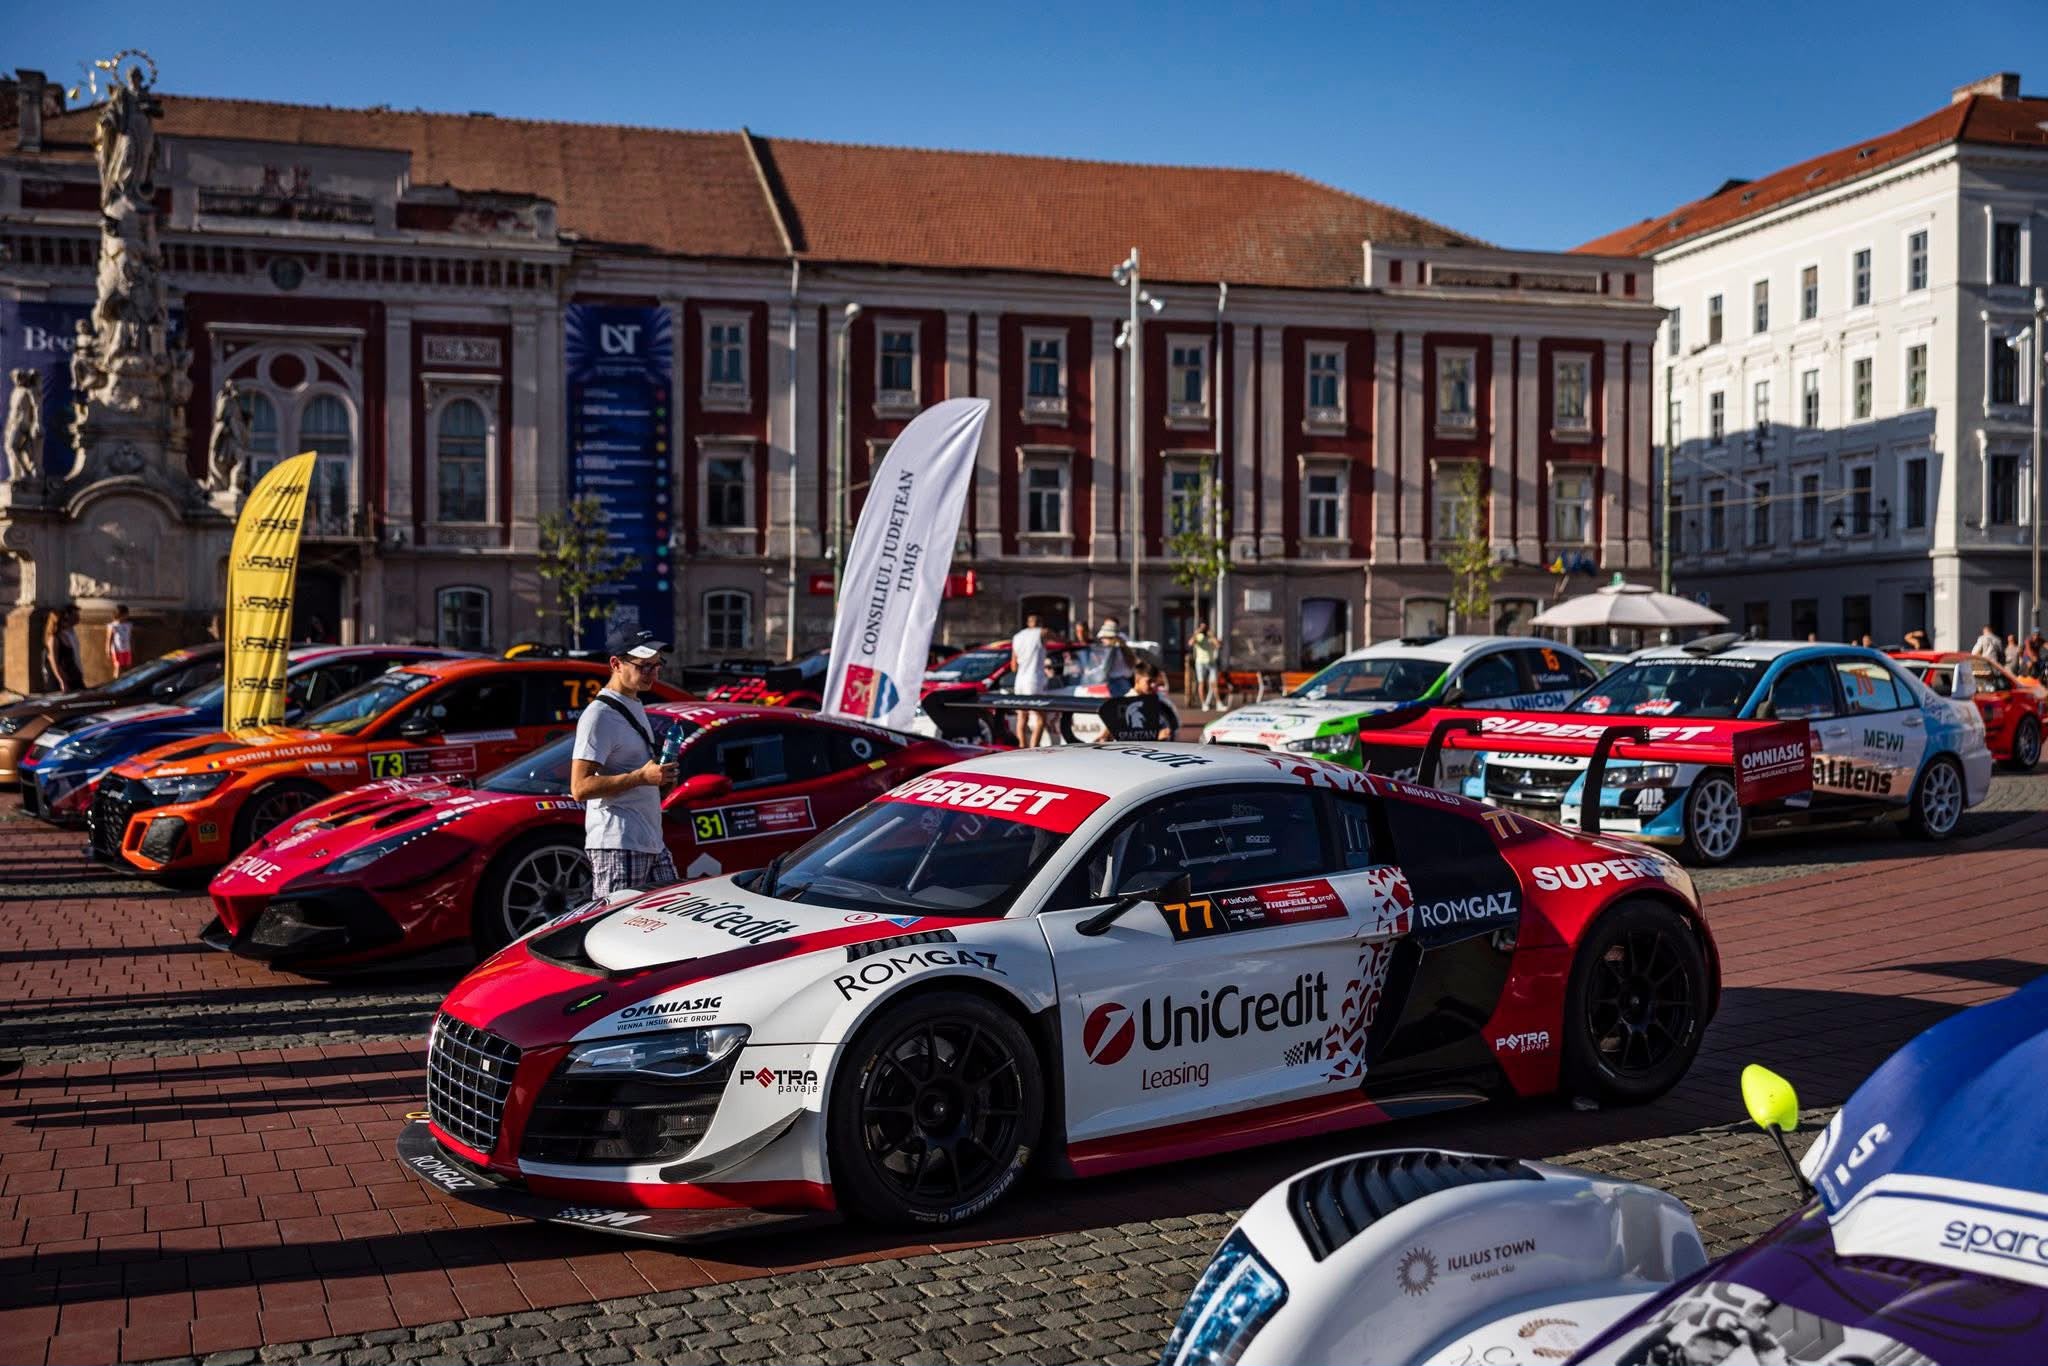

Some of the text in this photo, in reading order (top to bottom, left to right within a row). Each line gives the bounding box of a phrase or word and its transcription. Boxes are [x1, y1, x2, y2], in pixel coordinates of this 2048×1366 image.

[861, 562, 894, 656] CONSILIUL
[1510, 693, 1566, 709] UNICOM
[1481, 717, 1715, 741] SUPERET
[1863, 728, 1904, 753] MEWI
[225, 743, 333, 765] SORIN HUTANU
[371, 753, 404, 778] 73
[1742, 743, 1805, 769] OMNIASIG
[1829, 759, 1893, 794] Litens
[1402, 785, 1461, 806] MIHAI LEU
[696, 814, 723, 838] 31
[1481, 809, 1522, 839] 77
[656, 895, 800, 944] UniCredit
[1163, 899, 1215, 933] 77
[1264, 897, 1310, 910] TROFEUL
[1421, 891, 1518, 928] ROMGAZ
[833, 950, 1008, 1002] ROMGAZ
[620, 996, 723, 1019] OMNIASIG
[1142, 970, 1329, 1051] UniCredit
[617, 1014, 717, 1032] VIENNA INSURANCE GROUP
[778, 1084, 818, 1095] pavaje
[1142, 1060, 1209, 1091] Leasing
[409, 1155, 476, 1190] ROMGAZ
[1448, 1238, 1537, 1272] IULIUS TOWN
